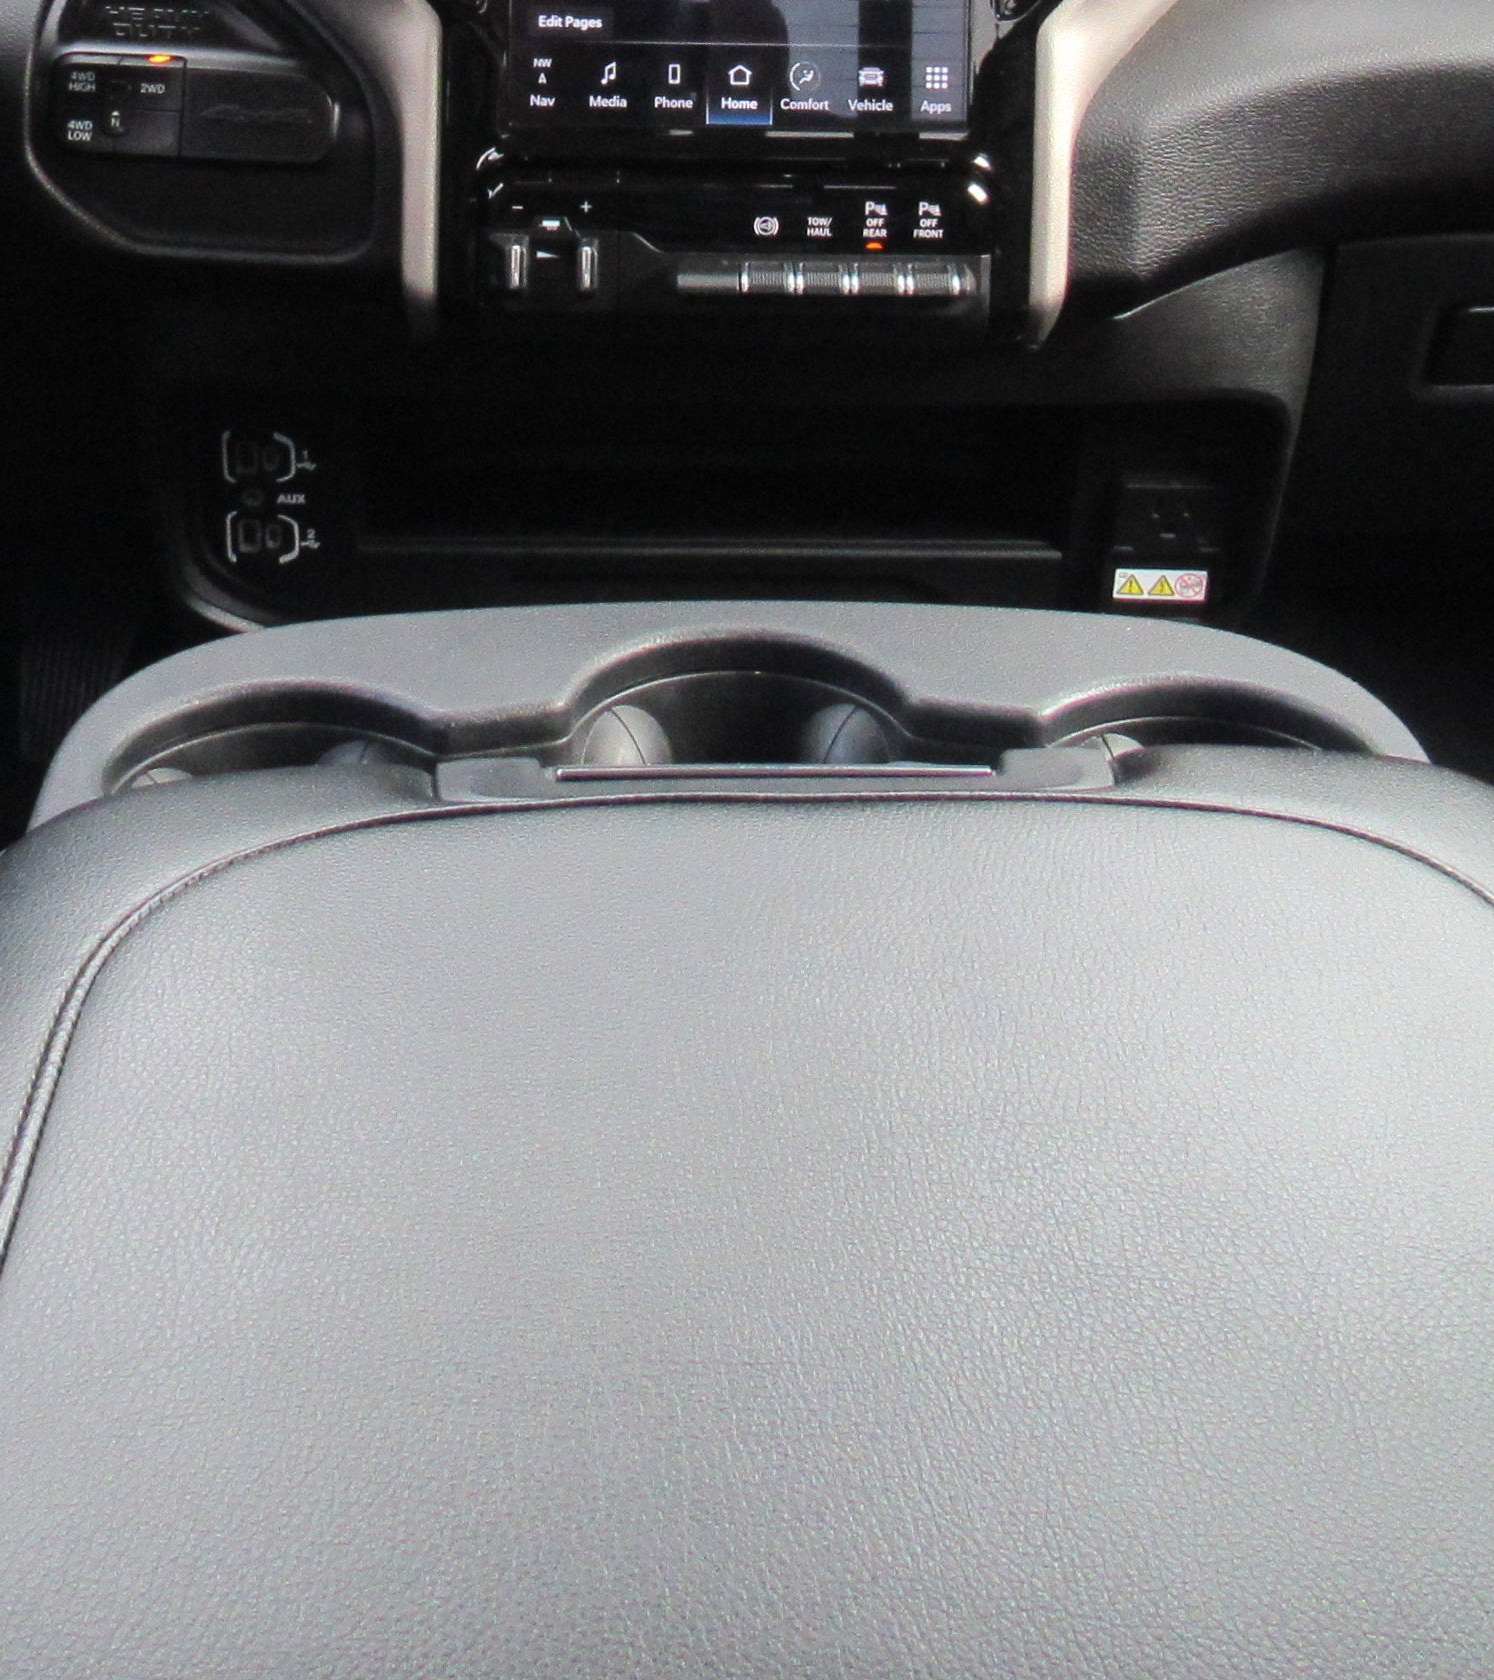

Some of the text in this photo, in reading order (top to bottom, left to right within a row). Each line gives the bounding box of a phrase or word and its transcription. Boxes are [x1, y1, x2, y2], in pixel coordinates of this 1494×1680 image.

[538, 14, 603, 31] Edit Pages
[533, 58, 552, 68] NW
[70, 71, 95, 81] 4WD
[68, 82, 96, 92] HIGH
[140, 84, 165, 94] 2WD
[529, 95, 556, 108] Nav
[589, 95, 627, 108] Media
[654, 96, 694, 109] Phone
[721, 97, 758, 110] Home
[780, 98, 829, 111] Comfort
[848, 99, 894, 112] Vehicle
[920, 100, 952, 114] Apps
[67, 120, 93, 130] 4WD
[111, 117, 120, 128] N
[67, 131, 93, 141] LOW
[807, 216, 832, 227] TOW/
[865, 218, 885, 227] OFF
[919, 218, 938, 228] OFF
[807, 227, 832, 237] HAUL
[863, 228, 887, 238] REAR
[913, 229, 944, 239] FRONT
[276, 494, 306, 504] AUX
